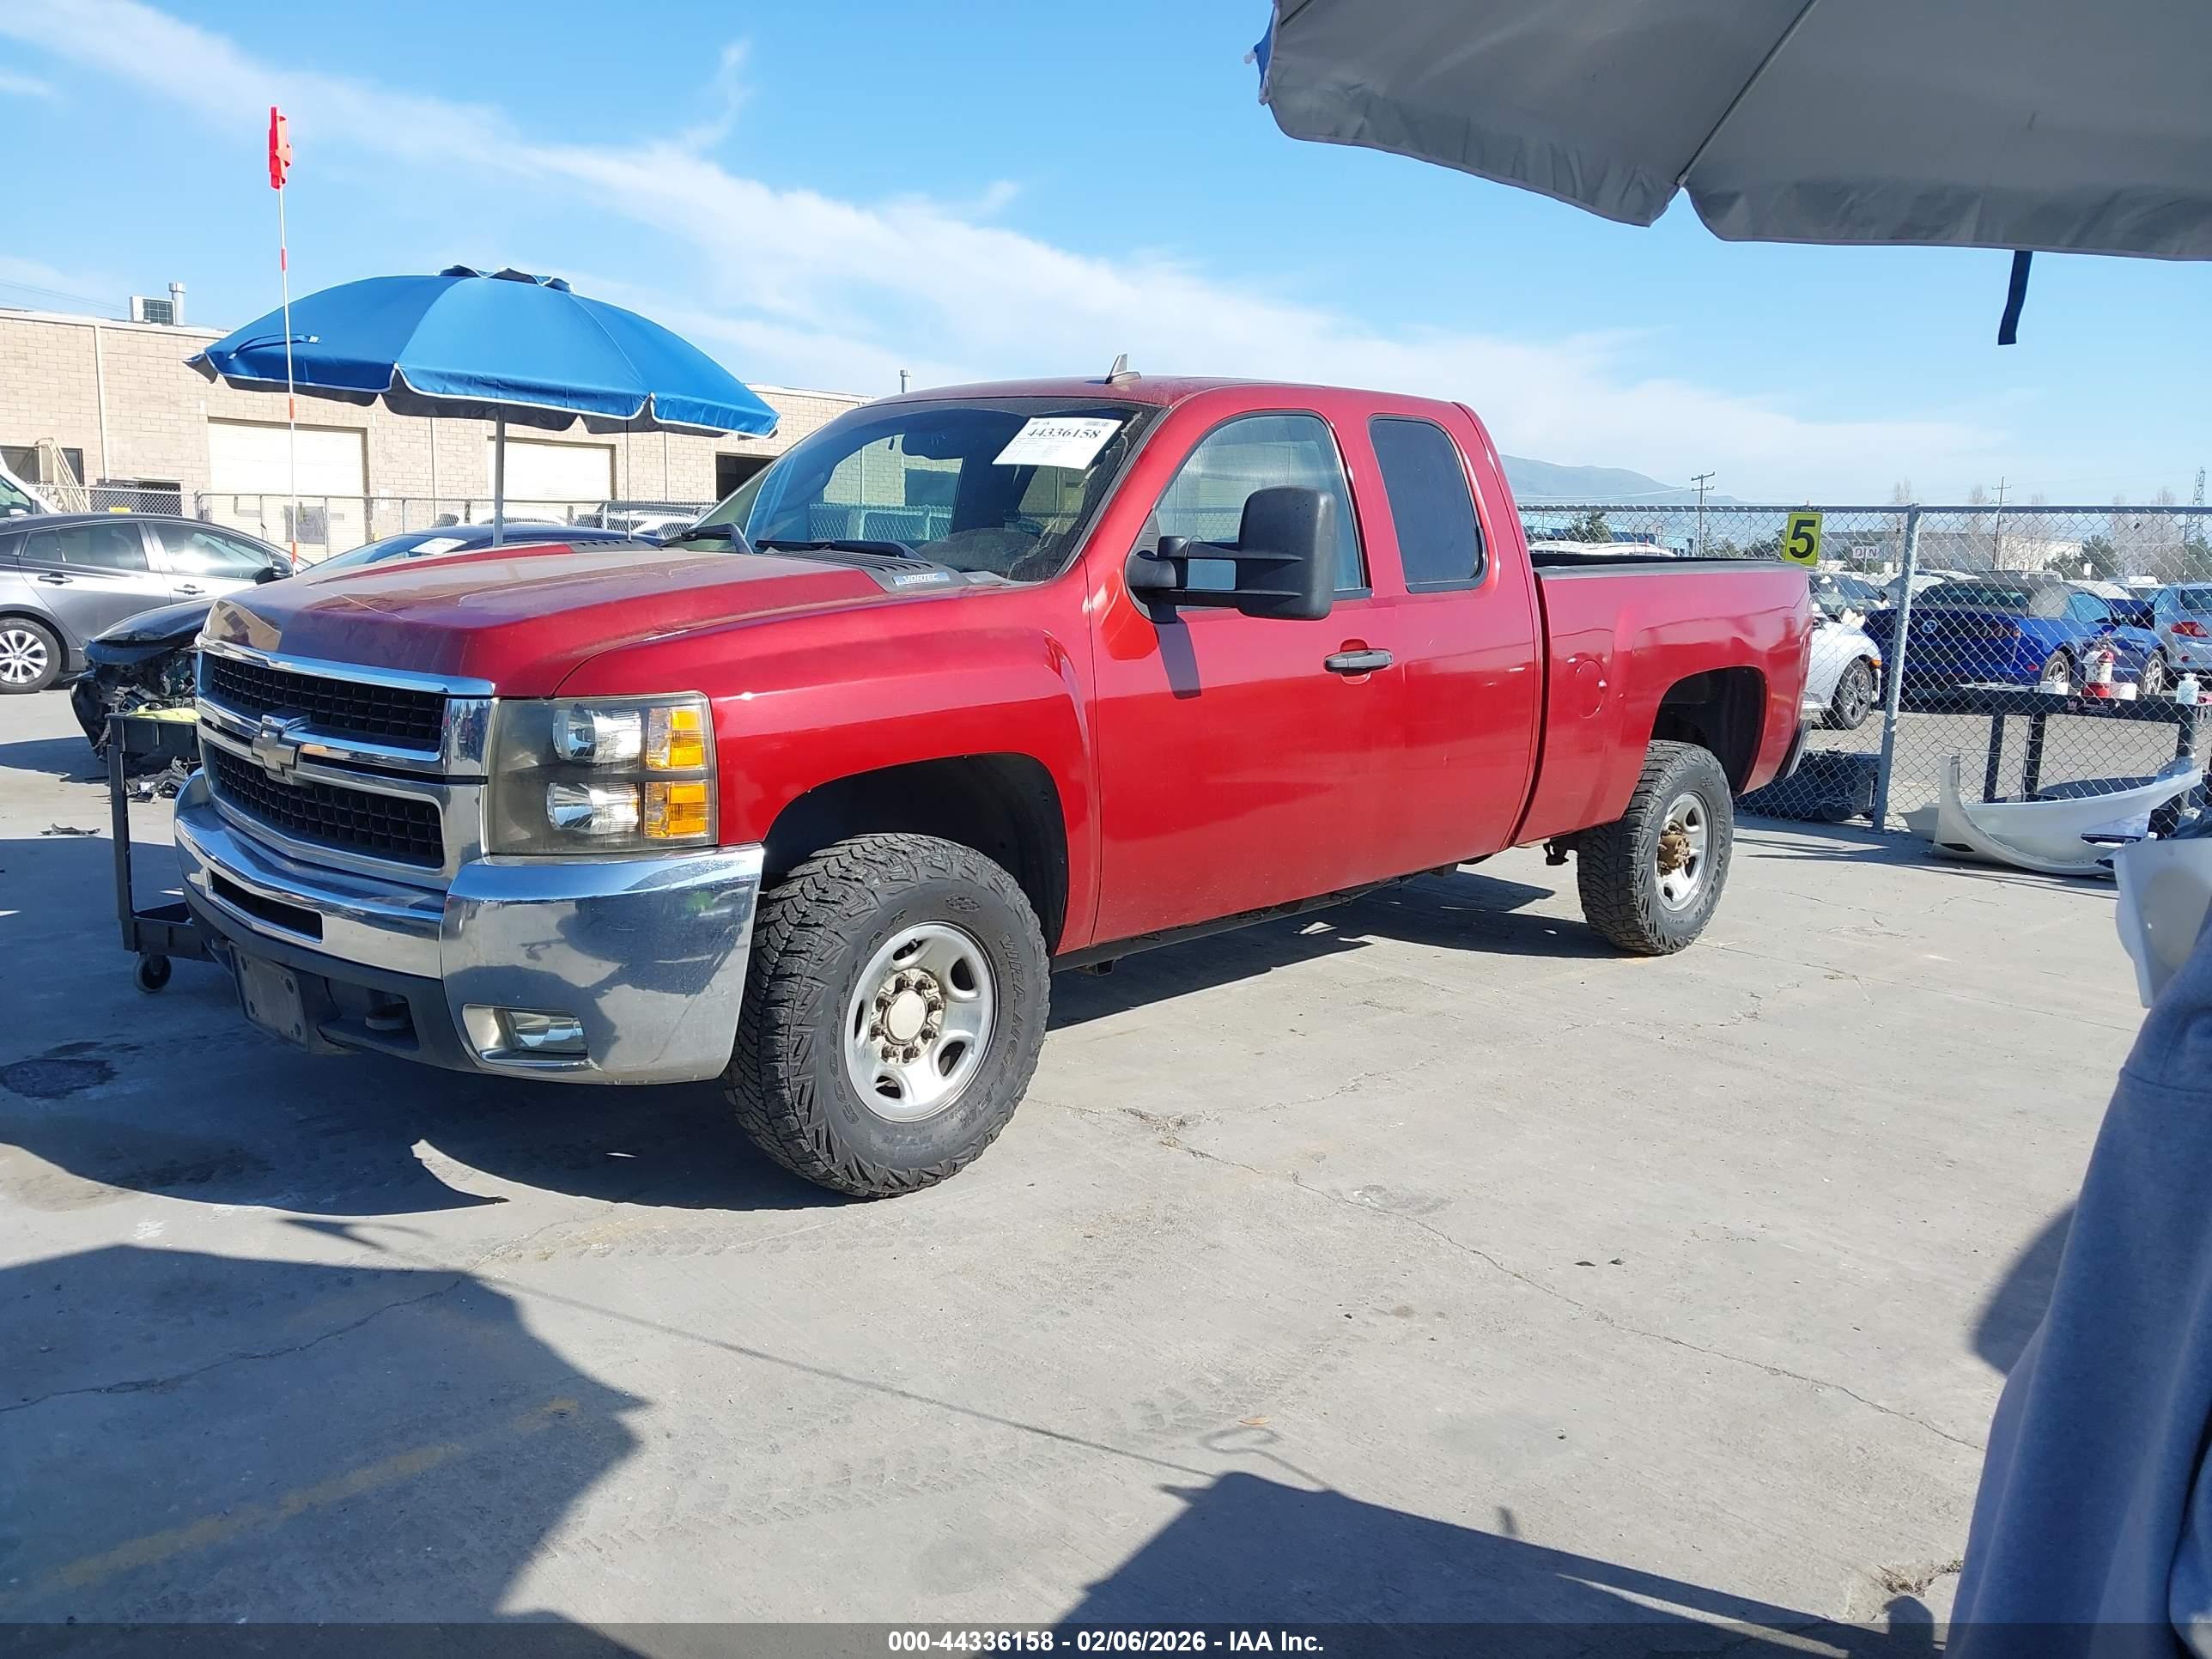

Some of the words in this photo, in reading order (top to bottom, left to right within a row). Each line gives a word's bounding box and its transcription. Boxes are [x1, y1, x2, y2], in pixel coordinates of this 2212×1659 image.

[1027, 427, 1102, 440] 44336158
[1789, 519, 1817, 559] 5
[902, 573, 938, 583] VORTEC
